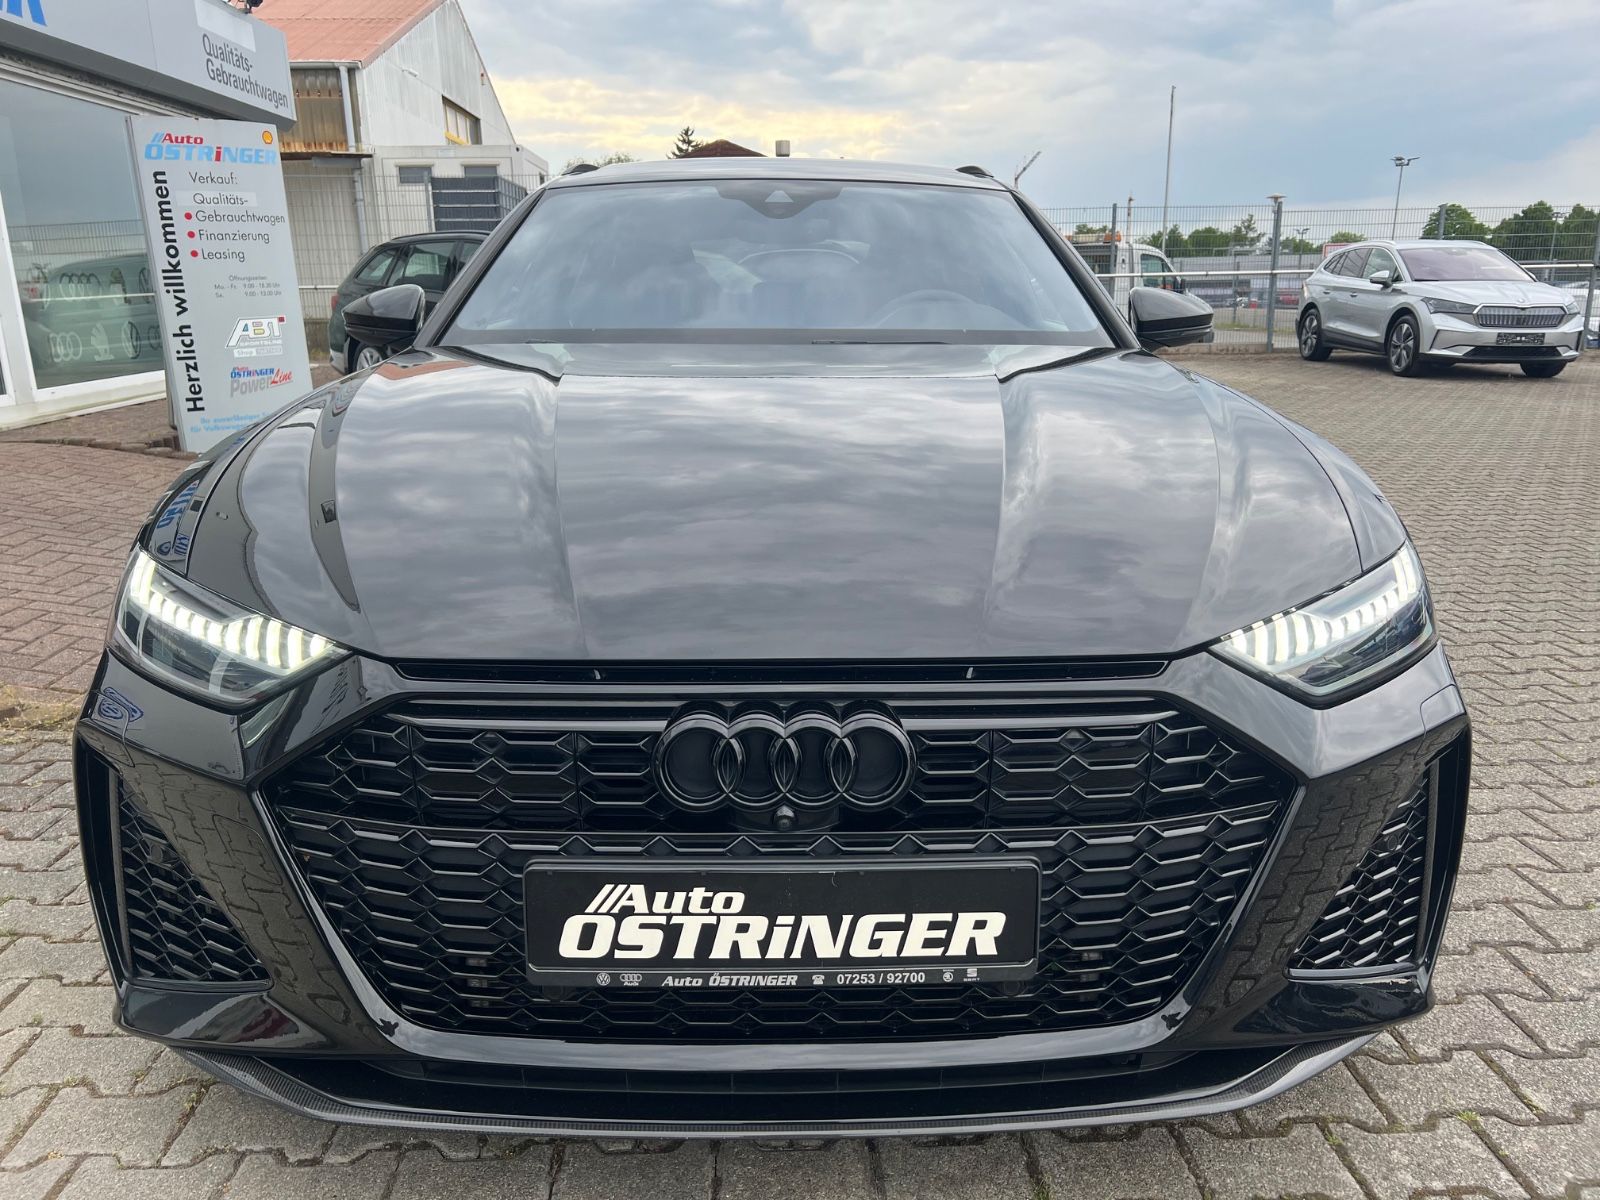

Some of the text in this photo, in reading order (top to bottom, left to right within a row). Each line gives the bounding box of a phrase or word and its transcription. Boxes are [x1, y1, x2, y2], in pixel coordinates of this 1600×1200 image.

[202, 33, 253, 73] Qualitäts-
[206, 57, 289, 109] Gebrauchtwagen
[188, 171, 238, 185] Verkauf:
[193, 192, 249, 206] Qualitäts-
[195, 209, 286, 226] Gebrauchtwagen
[198, 228, 270, 244] Finanzierung
[201, 247, 246, 263] Leasing
[152, 170, 206, 413] Herzlich willkommen
[225, 315, 286, 348] ABT
[661, 976, 703, 987] Auto
[708, 972, 798, 987] ÖSTRINGER
[836, 973, 876, 985] 07253
[886, 972, 926, 984] 92700
